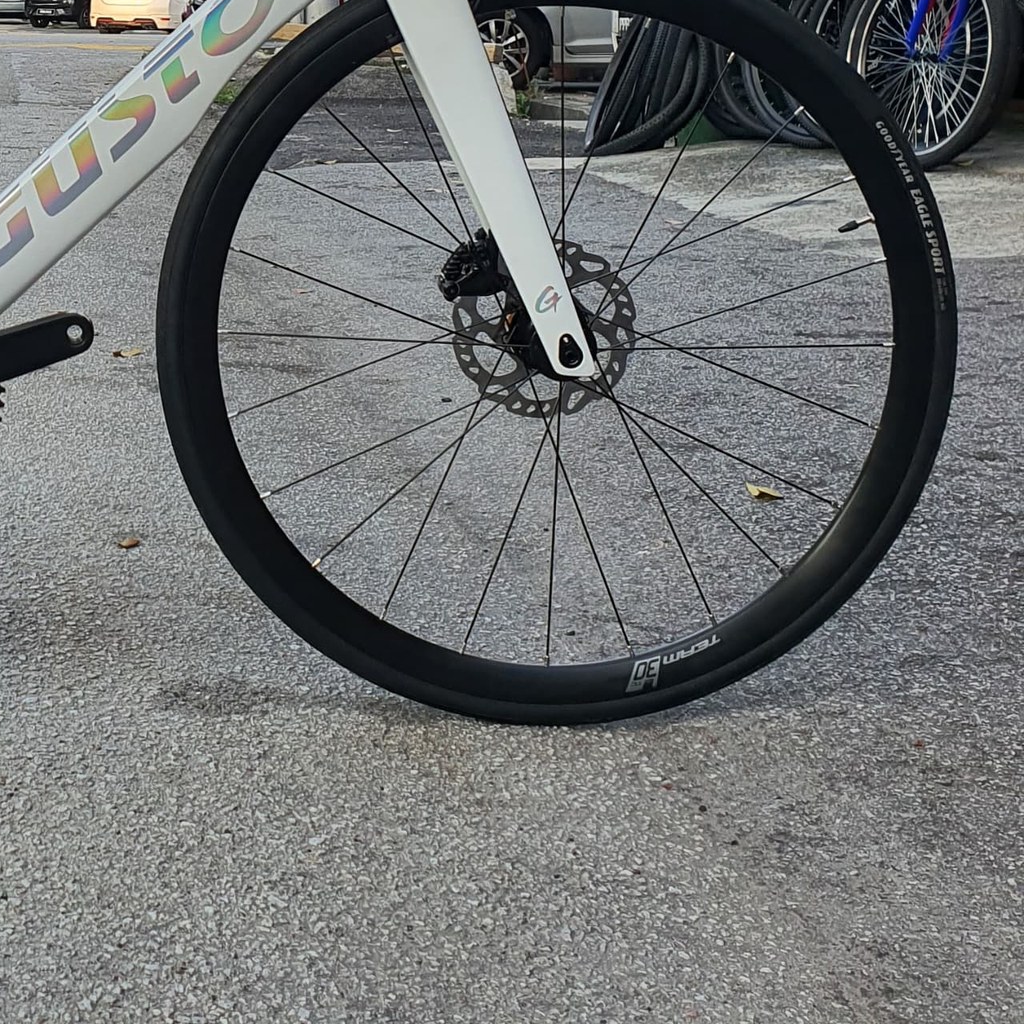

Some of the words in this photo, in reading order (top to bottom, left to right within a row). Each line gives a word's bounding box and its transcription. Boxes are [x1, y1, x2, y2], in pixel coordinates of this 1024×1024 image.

[876, 120, 914, 183] GOODYEAR
[910, 188, 934, 228] EAGLE
[926, 230, 946, 275] SPORT
[632, 657, 660, 682] 30
